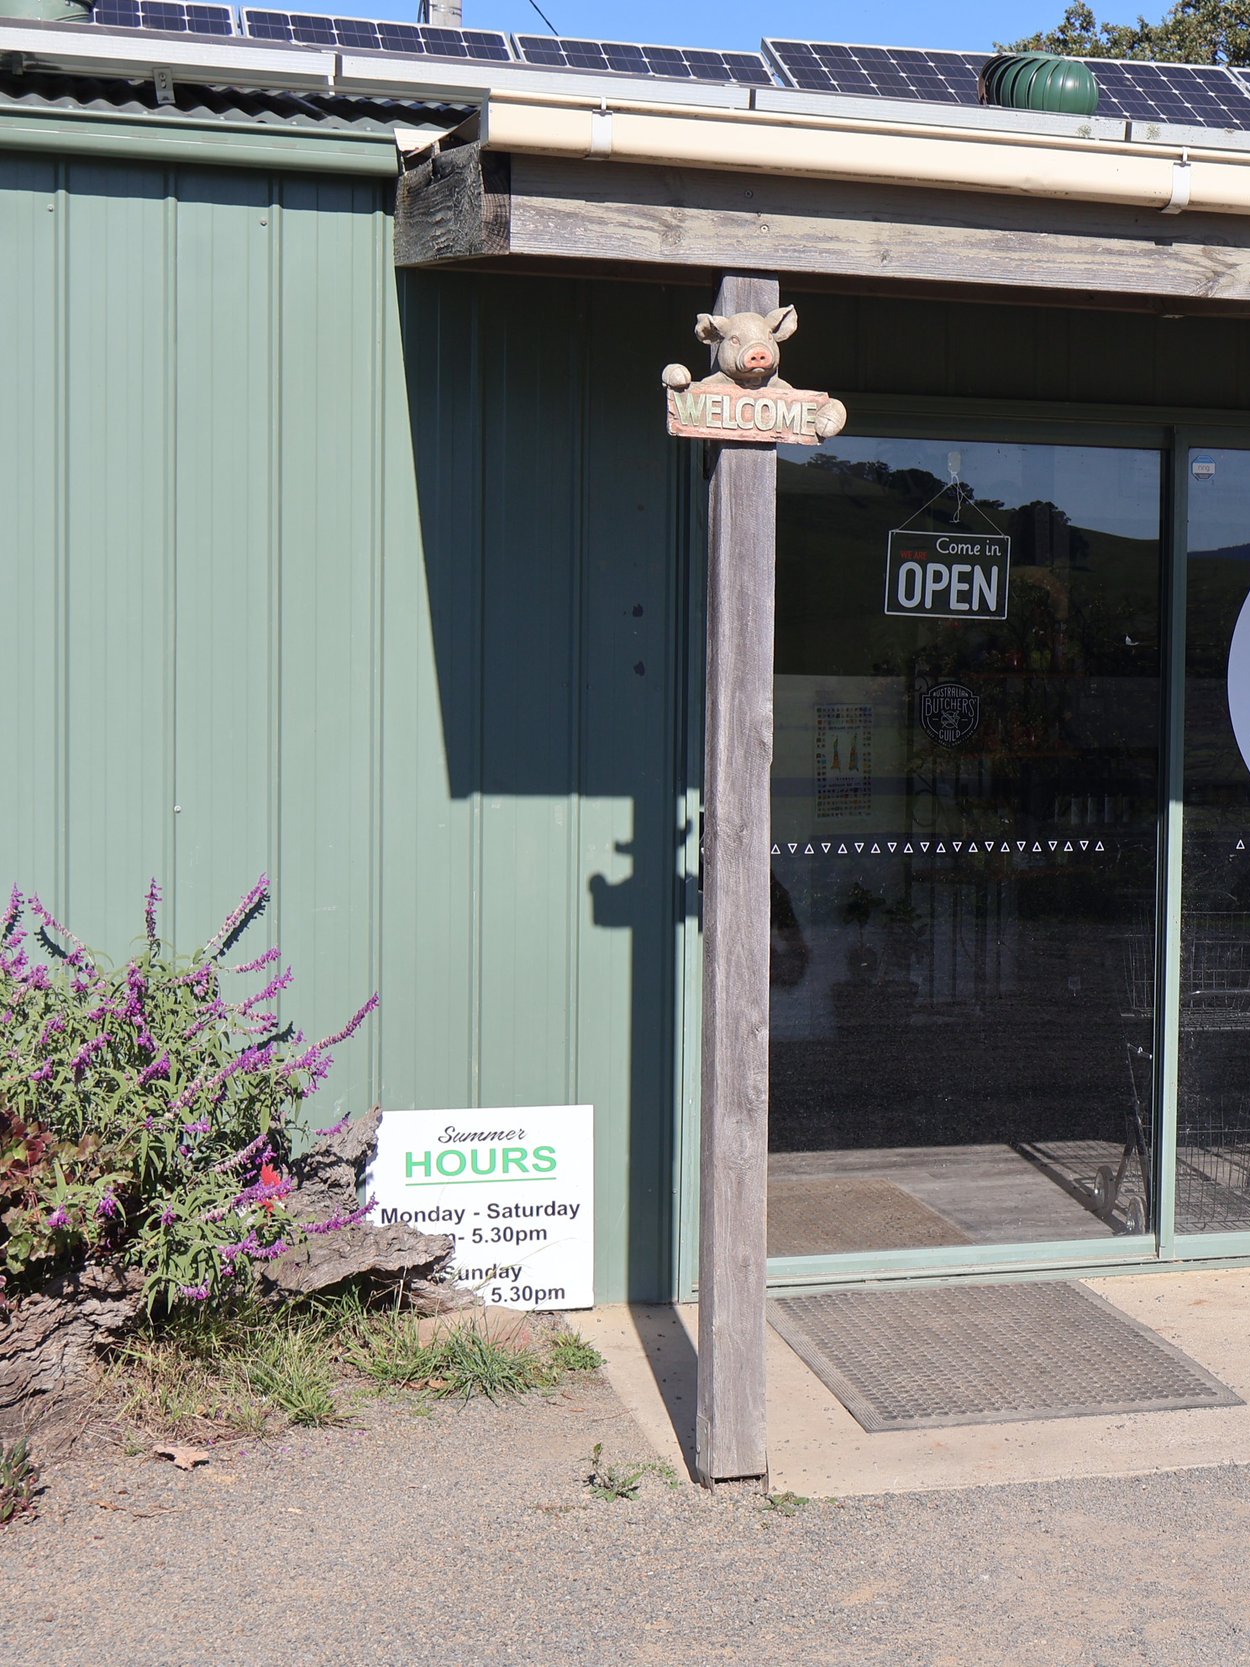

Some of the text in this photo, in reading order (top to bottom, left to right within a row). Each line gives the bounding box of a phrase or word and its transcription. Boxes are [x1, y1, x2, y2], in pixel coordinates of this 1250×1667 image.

[674, 392, 817, 436] WELCOME
[936, 537, 1002, 556] Come in
[897, 561, 999, 612] OPEN
[938, 729, 961, 742] GUILD
[437, 1125, 529, 1144] Summer
[405, 1145, 557, 1178] HOURS
[381, 1206, 466, 1225] Monday
[487, 1200, 581, 1220] Saturday
[472, 1226, 548, 1246] 5.30pm
[443, 1263, 522, 1283] Sunday
[491, 1285, 566, 1305] 5.30pm
